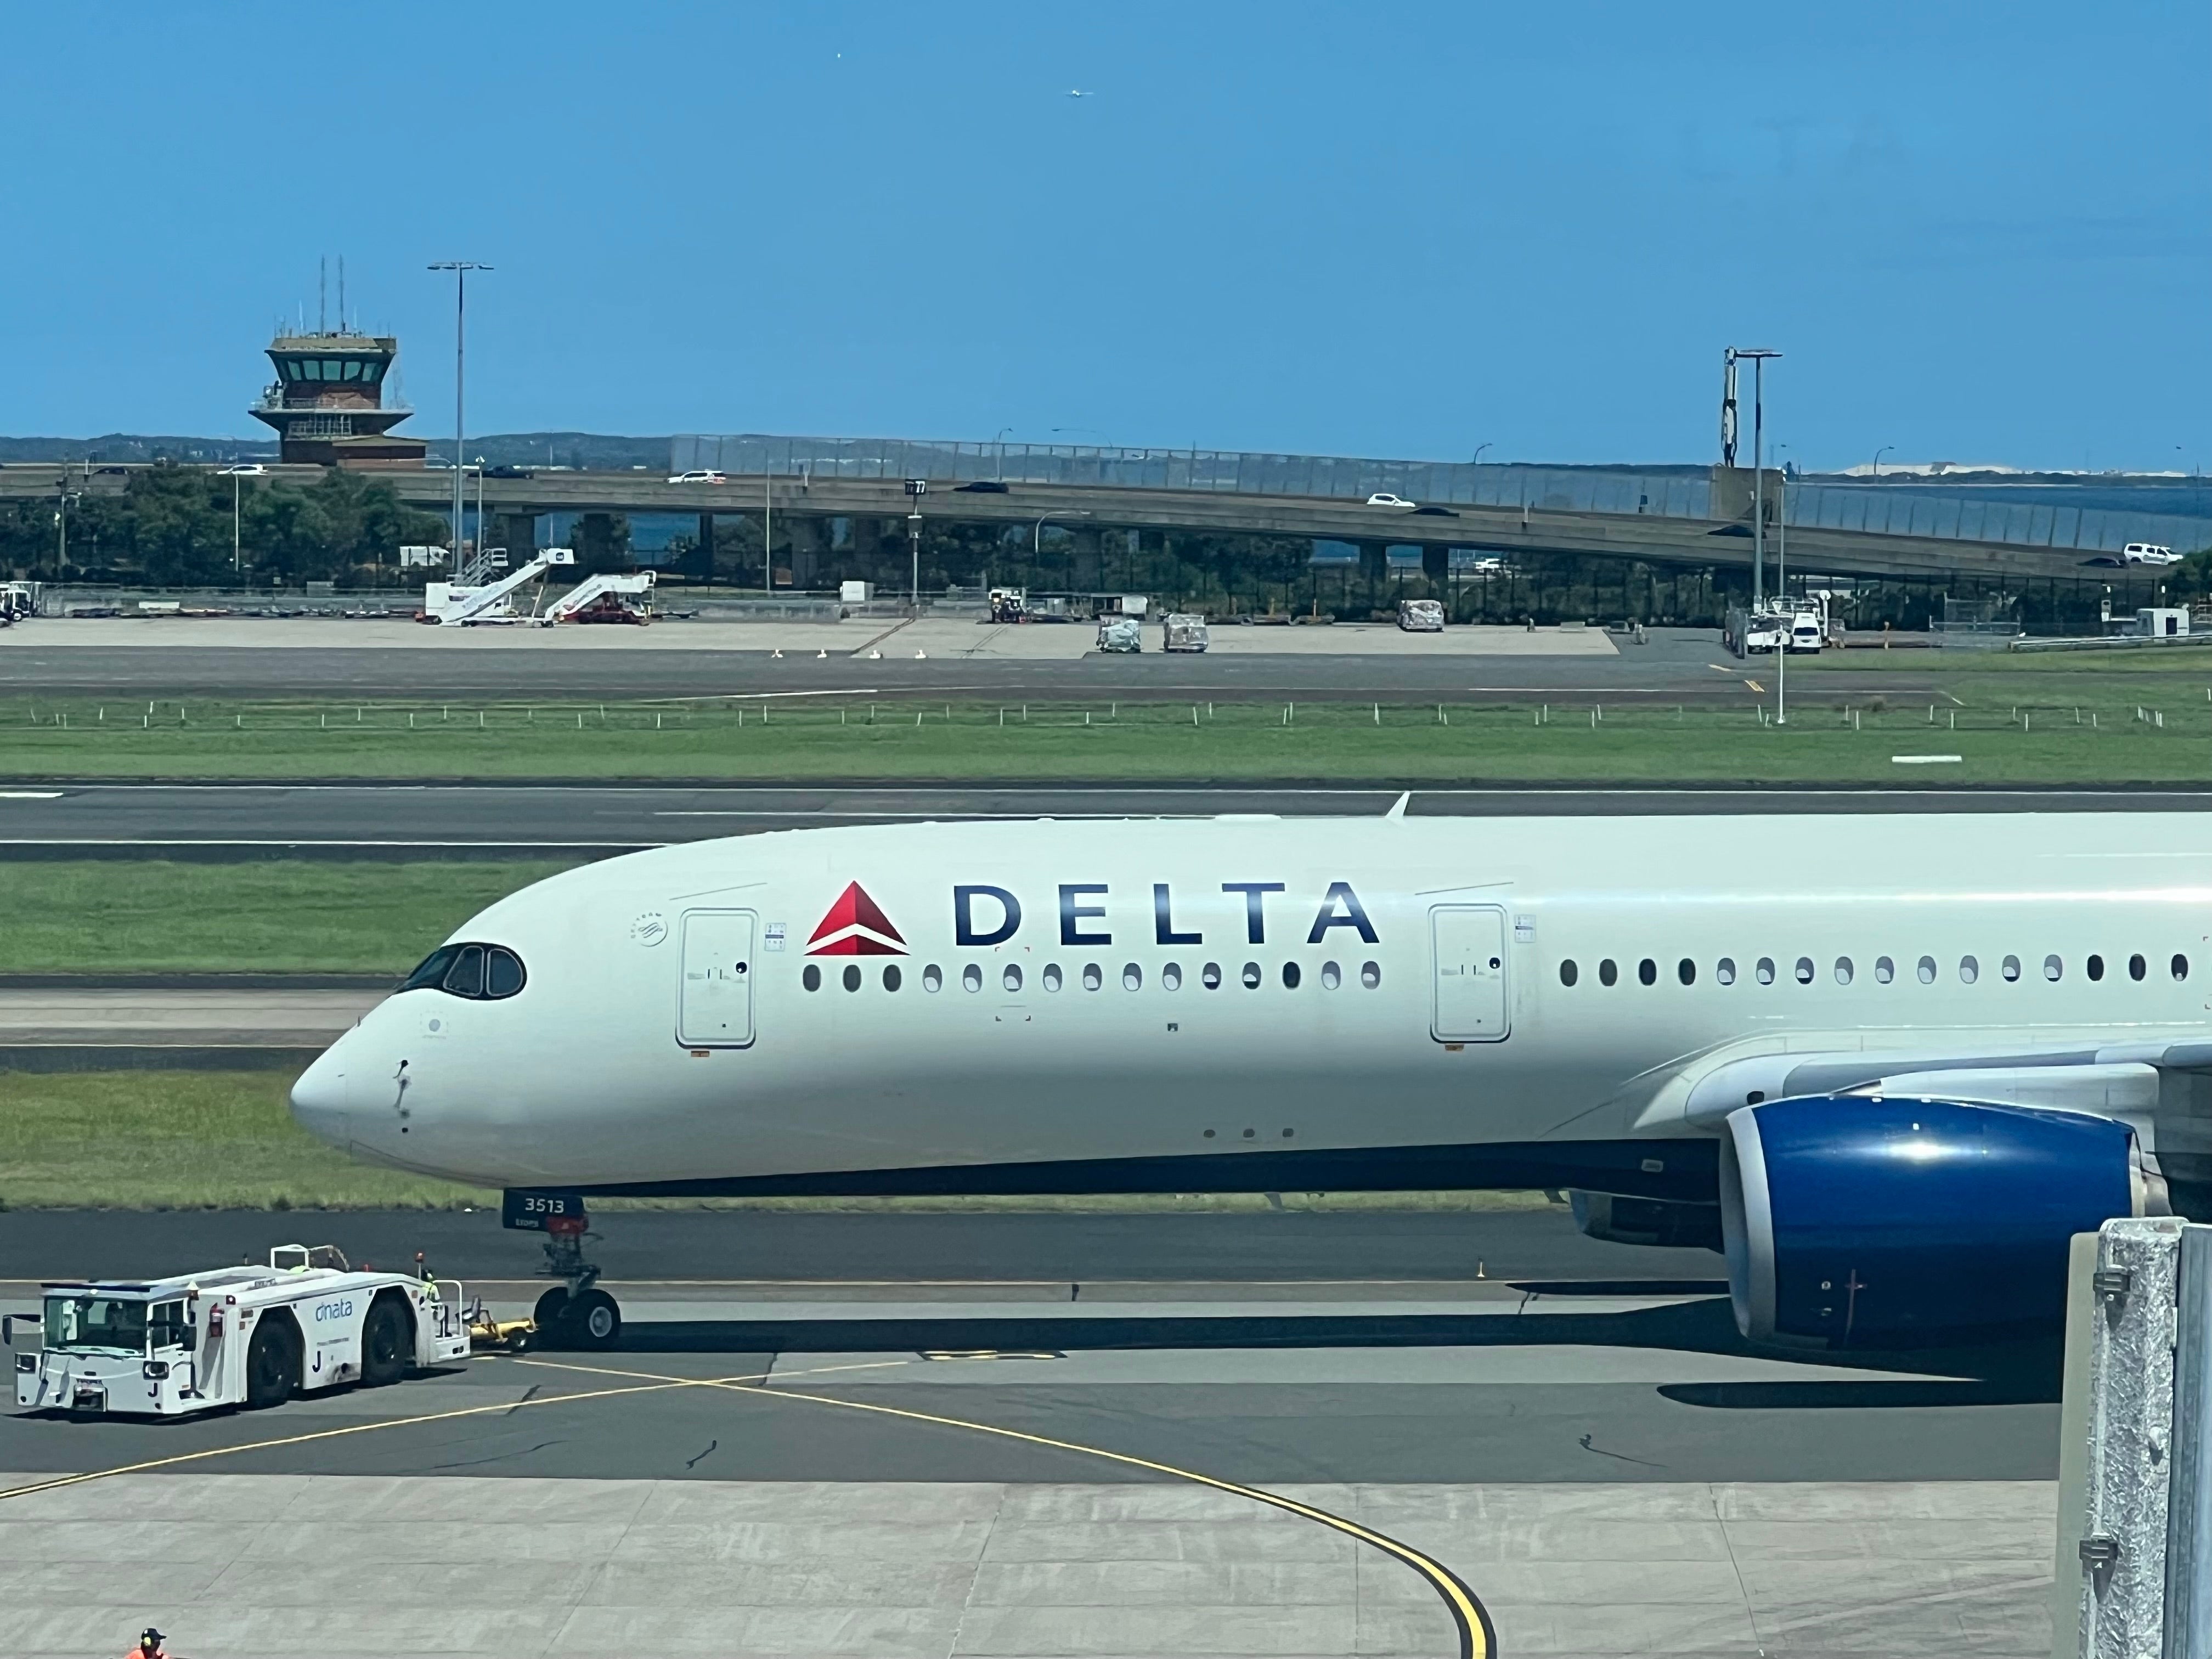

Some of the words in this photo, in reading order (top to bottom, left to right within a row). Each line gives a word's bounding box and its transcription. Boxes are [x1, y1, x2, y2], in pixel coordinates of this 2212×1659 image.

[953, 881, 1380, 946] DELTA
[525, 1198, 565, 1214] 3513
[315, 1298, 353, 1322] dnata
[312, 1351, 321, 1373] J
[148, 1383, 158, 1397] J
